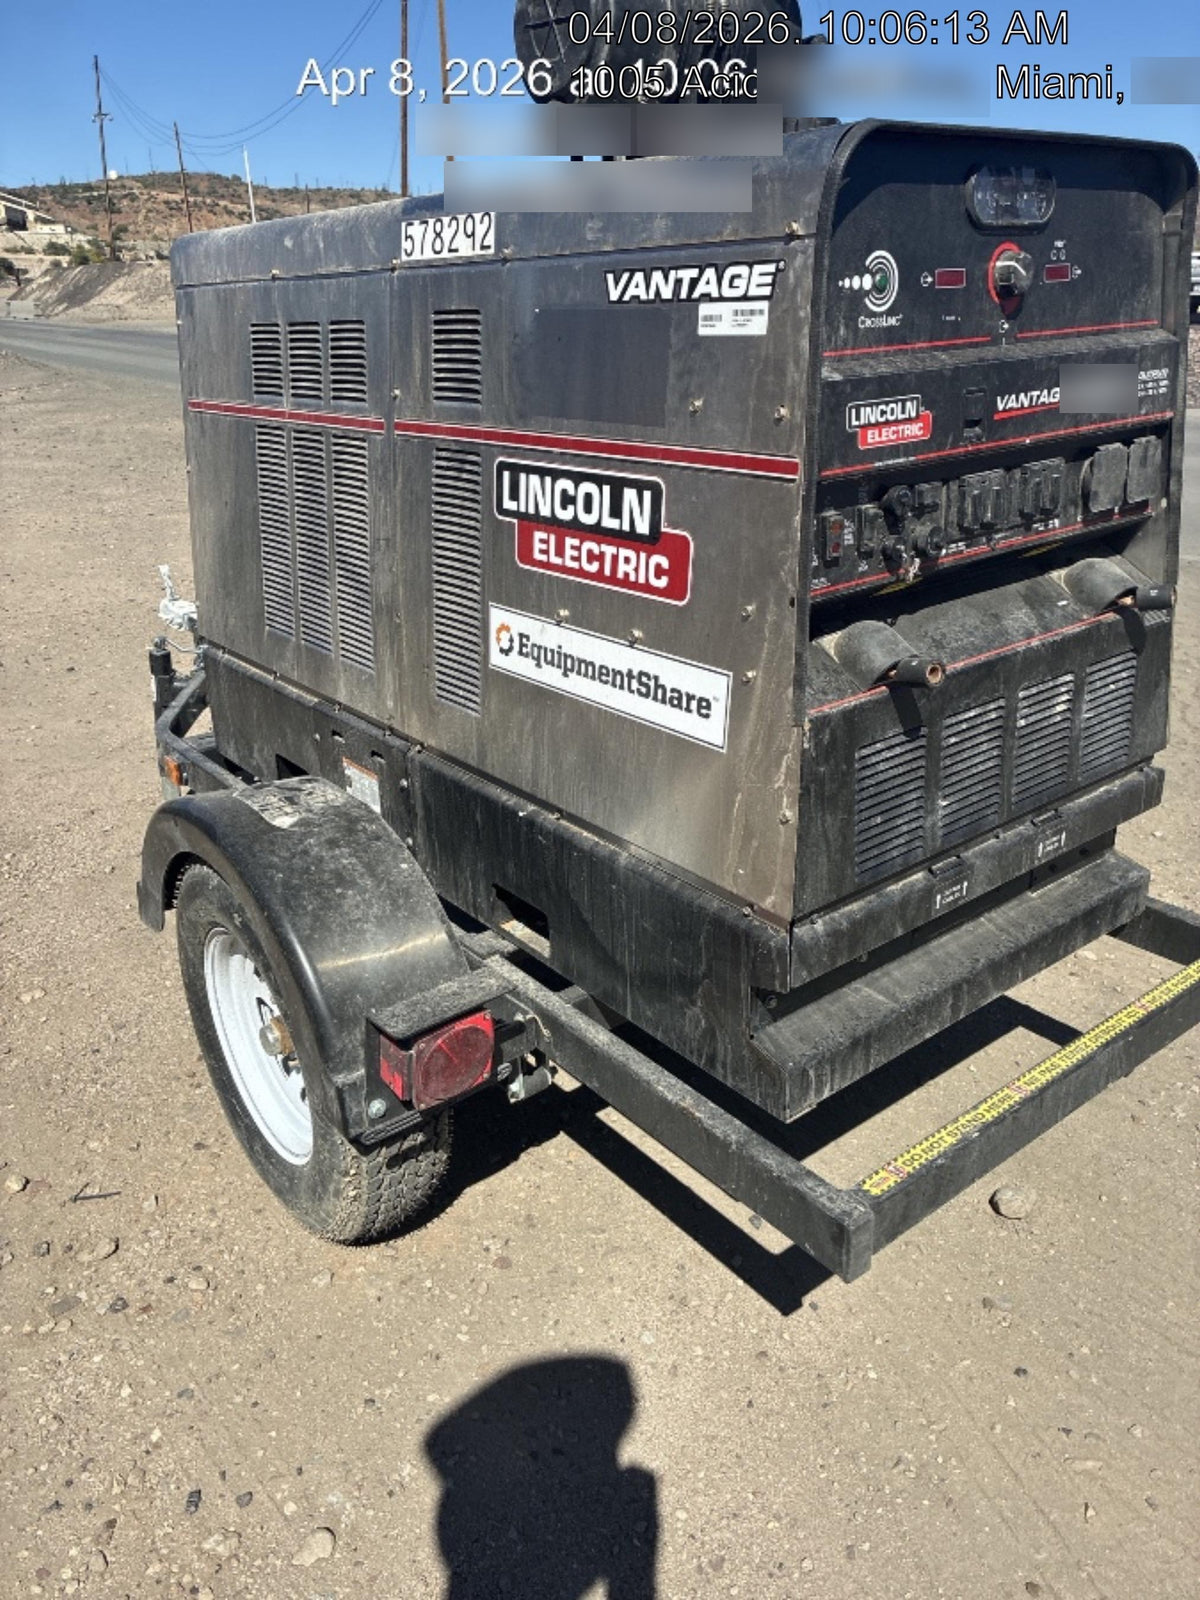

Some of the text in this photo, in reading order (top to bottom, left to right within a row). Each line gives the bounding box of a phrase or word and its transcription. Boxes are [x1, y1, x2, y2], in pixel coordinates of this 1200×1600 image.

[404, 212, 492, 257] 578292
[851, 400, 917, 426] LINCOLN
[997, 387, 1061, 411] VANTAG
[867, 423, 923, 443] ELECTRIC
[502, 470, 652, 535] LINCOLN
[533, 531, 669, 588] ELECTRIC
[518, 632, 712, 719] EquipmentShare
[902, 1093, 1014, 1167] DO NOT STAND HERE
